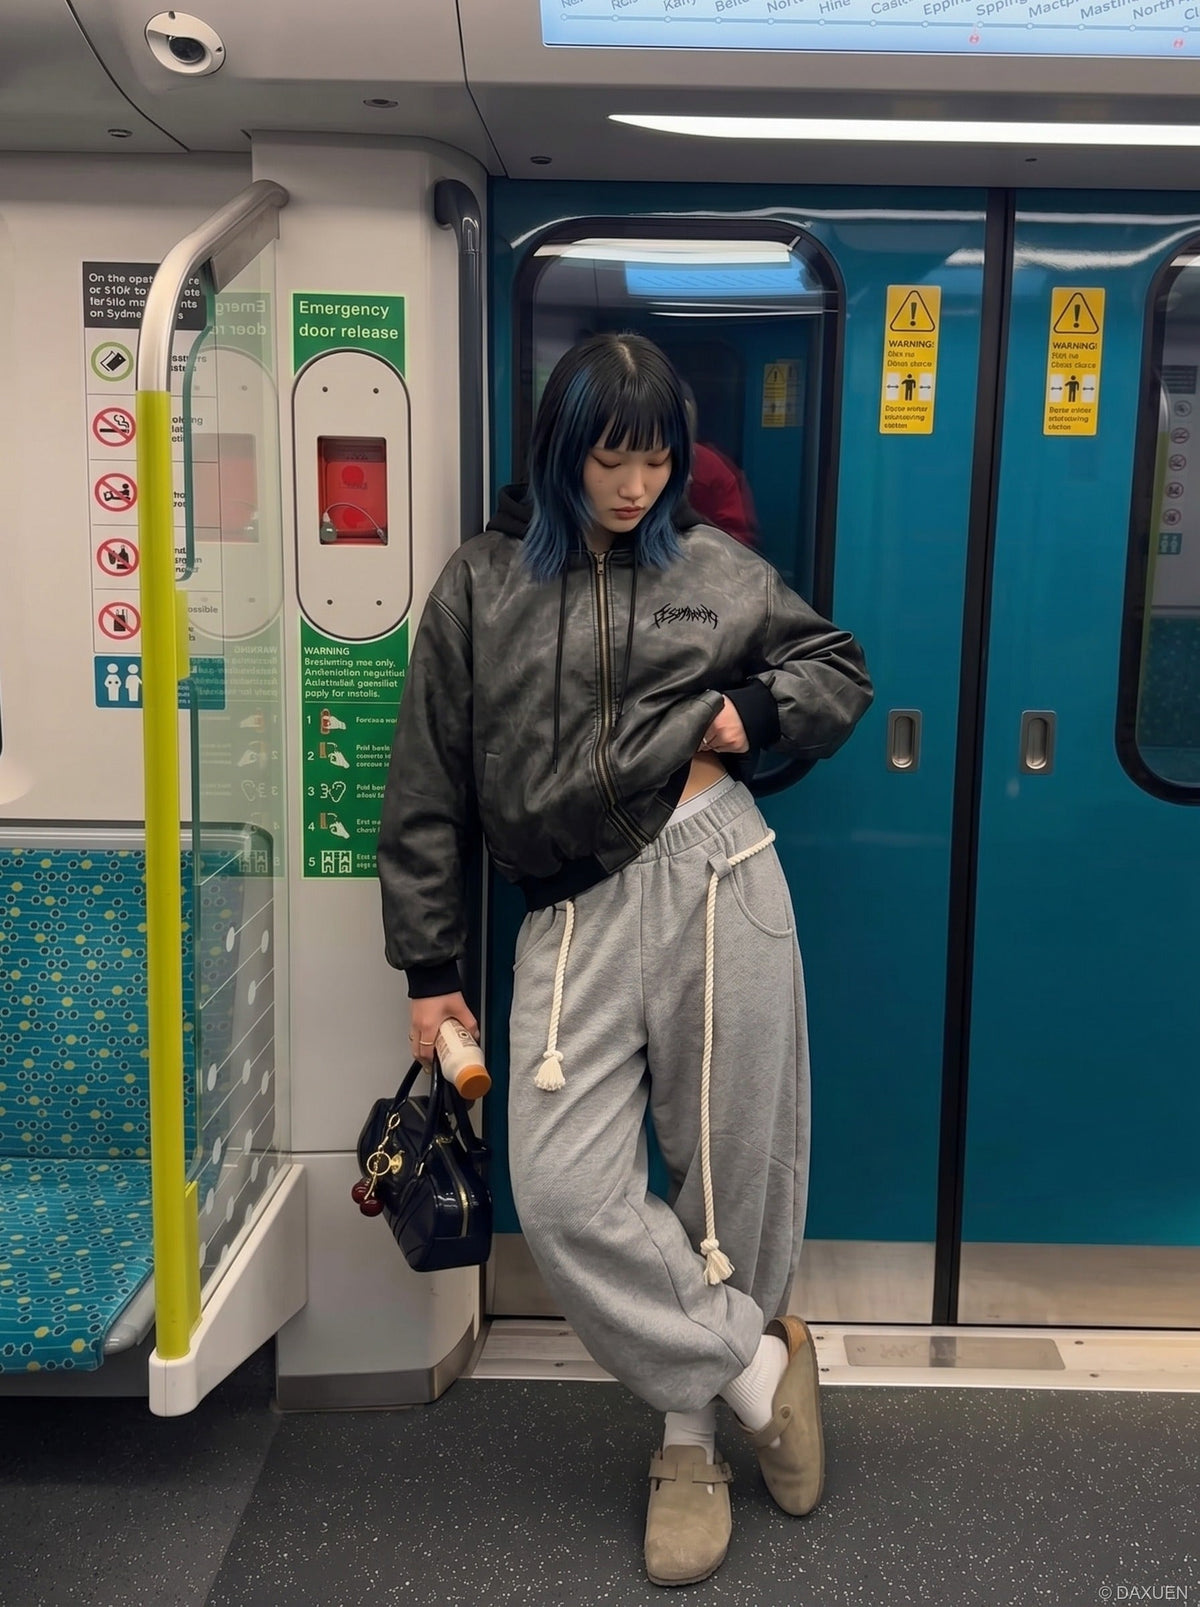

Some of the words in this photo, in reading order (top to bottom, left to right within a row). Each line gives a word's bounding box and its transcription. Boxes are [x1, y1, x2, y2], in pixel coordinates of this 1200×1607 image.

[1133, 0, 1174, 20] North
[89, 273, 105, 282] On
[108, 274, 126, 282] the
[90, 309, 104, 317] on
[300, 301, 389, 319] Emergency
[299, 323, 336, 337] door
[341, 325, 398, 339] release
[304, 647, 350, 655] WARNING
[375, 659, 396, 669] only.
[307, 716, 312, 724] 1
[308, 752, 315, 761] 2
[308, 787, 315, 796] 3
[308, 822, 316, 832] 4
[308, 857, 316, 867] 5
